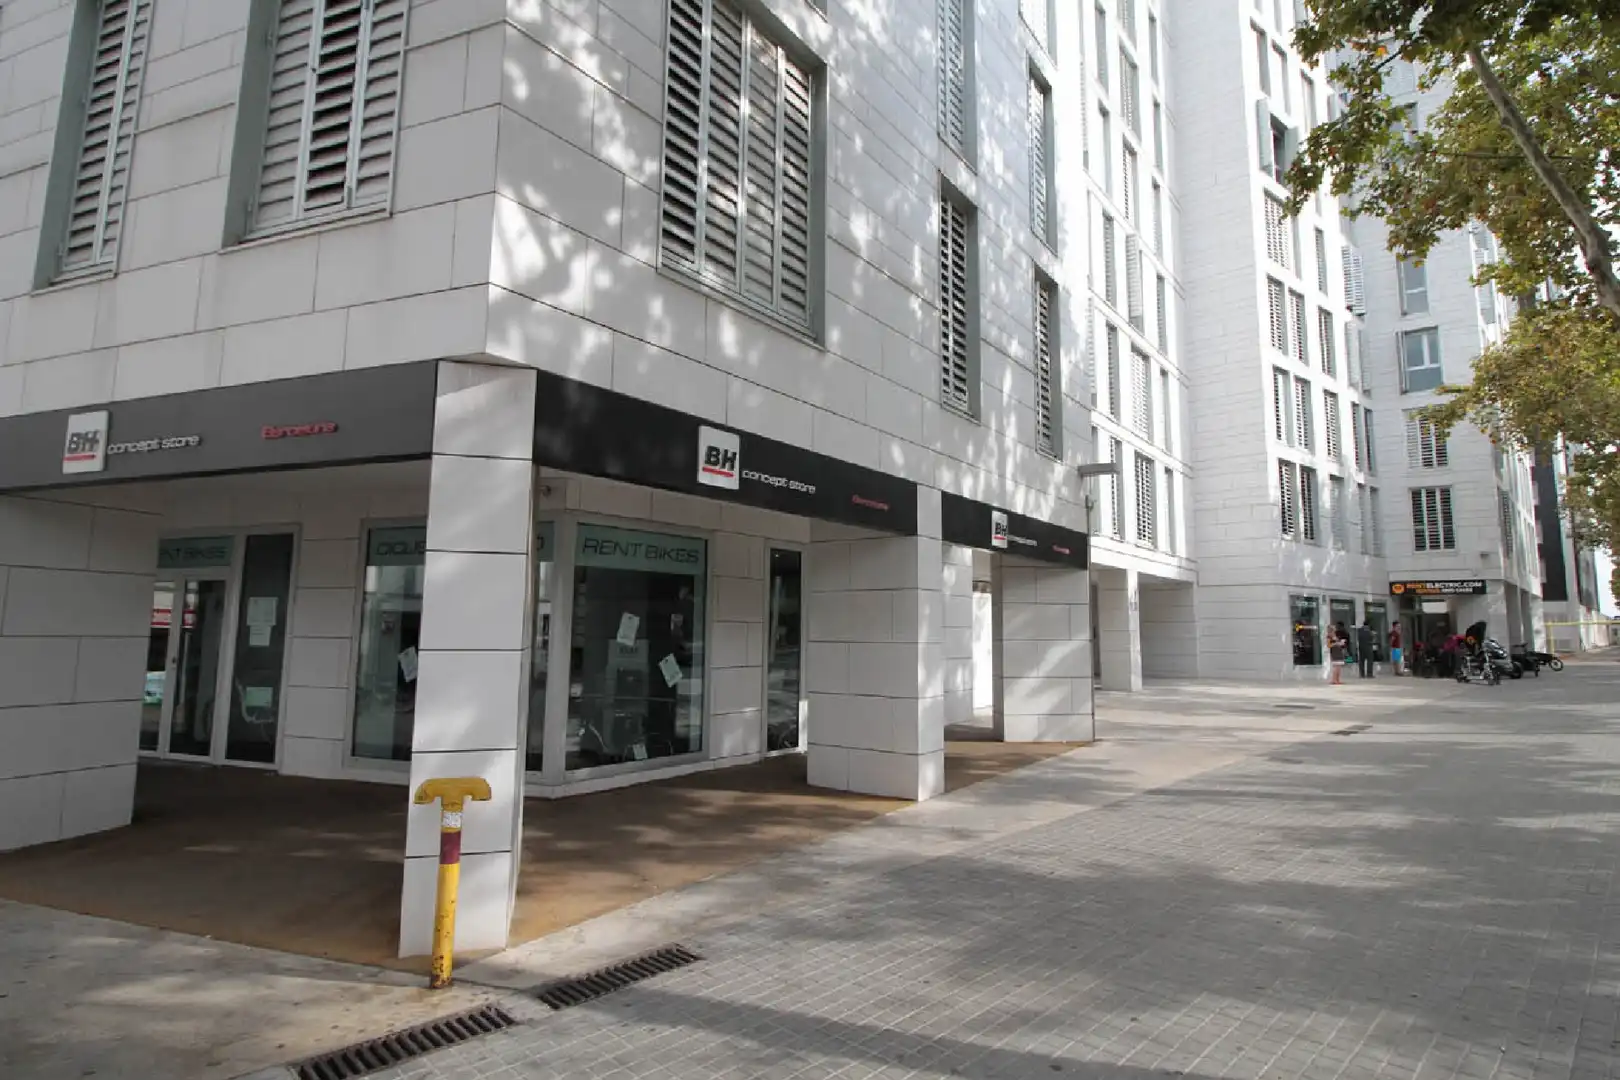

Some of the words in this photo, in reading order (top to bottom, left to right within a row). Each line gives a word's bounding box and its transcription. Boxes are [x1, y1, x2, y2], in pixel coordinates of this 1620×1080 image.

[107, 437, 160, 455] concept
[161, 434, 200, 449] store
[704, 446, 737, 471] BH
[741, 470, 788, 488] concept
[789, 479, 816, 495] store
[582, 537, 643, 557] RENT
[644, 545, 700, 564] BIKES
